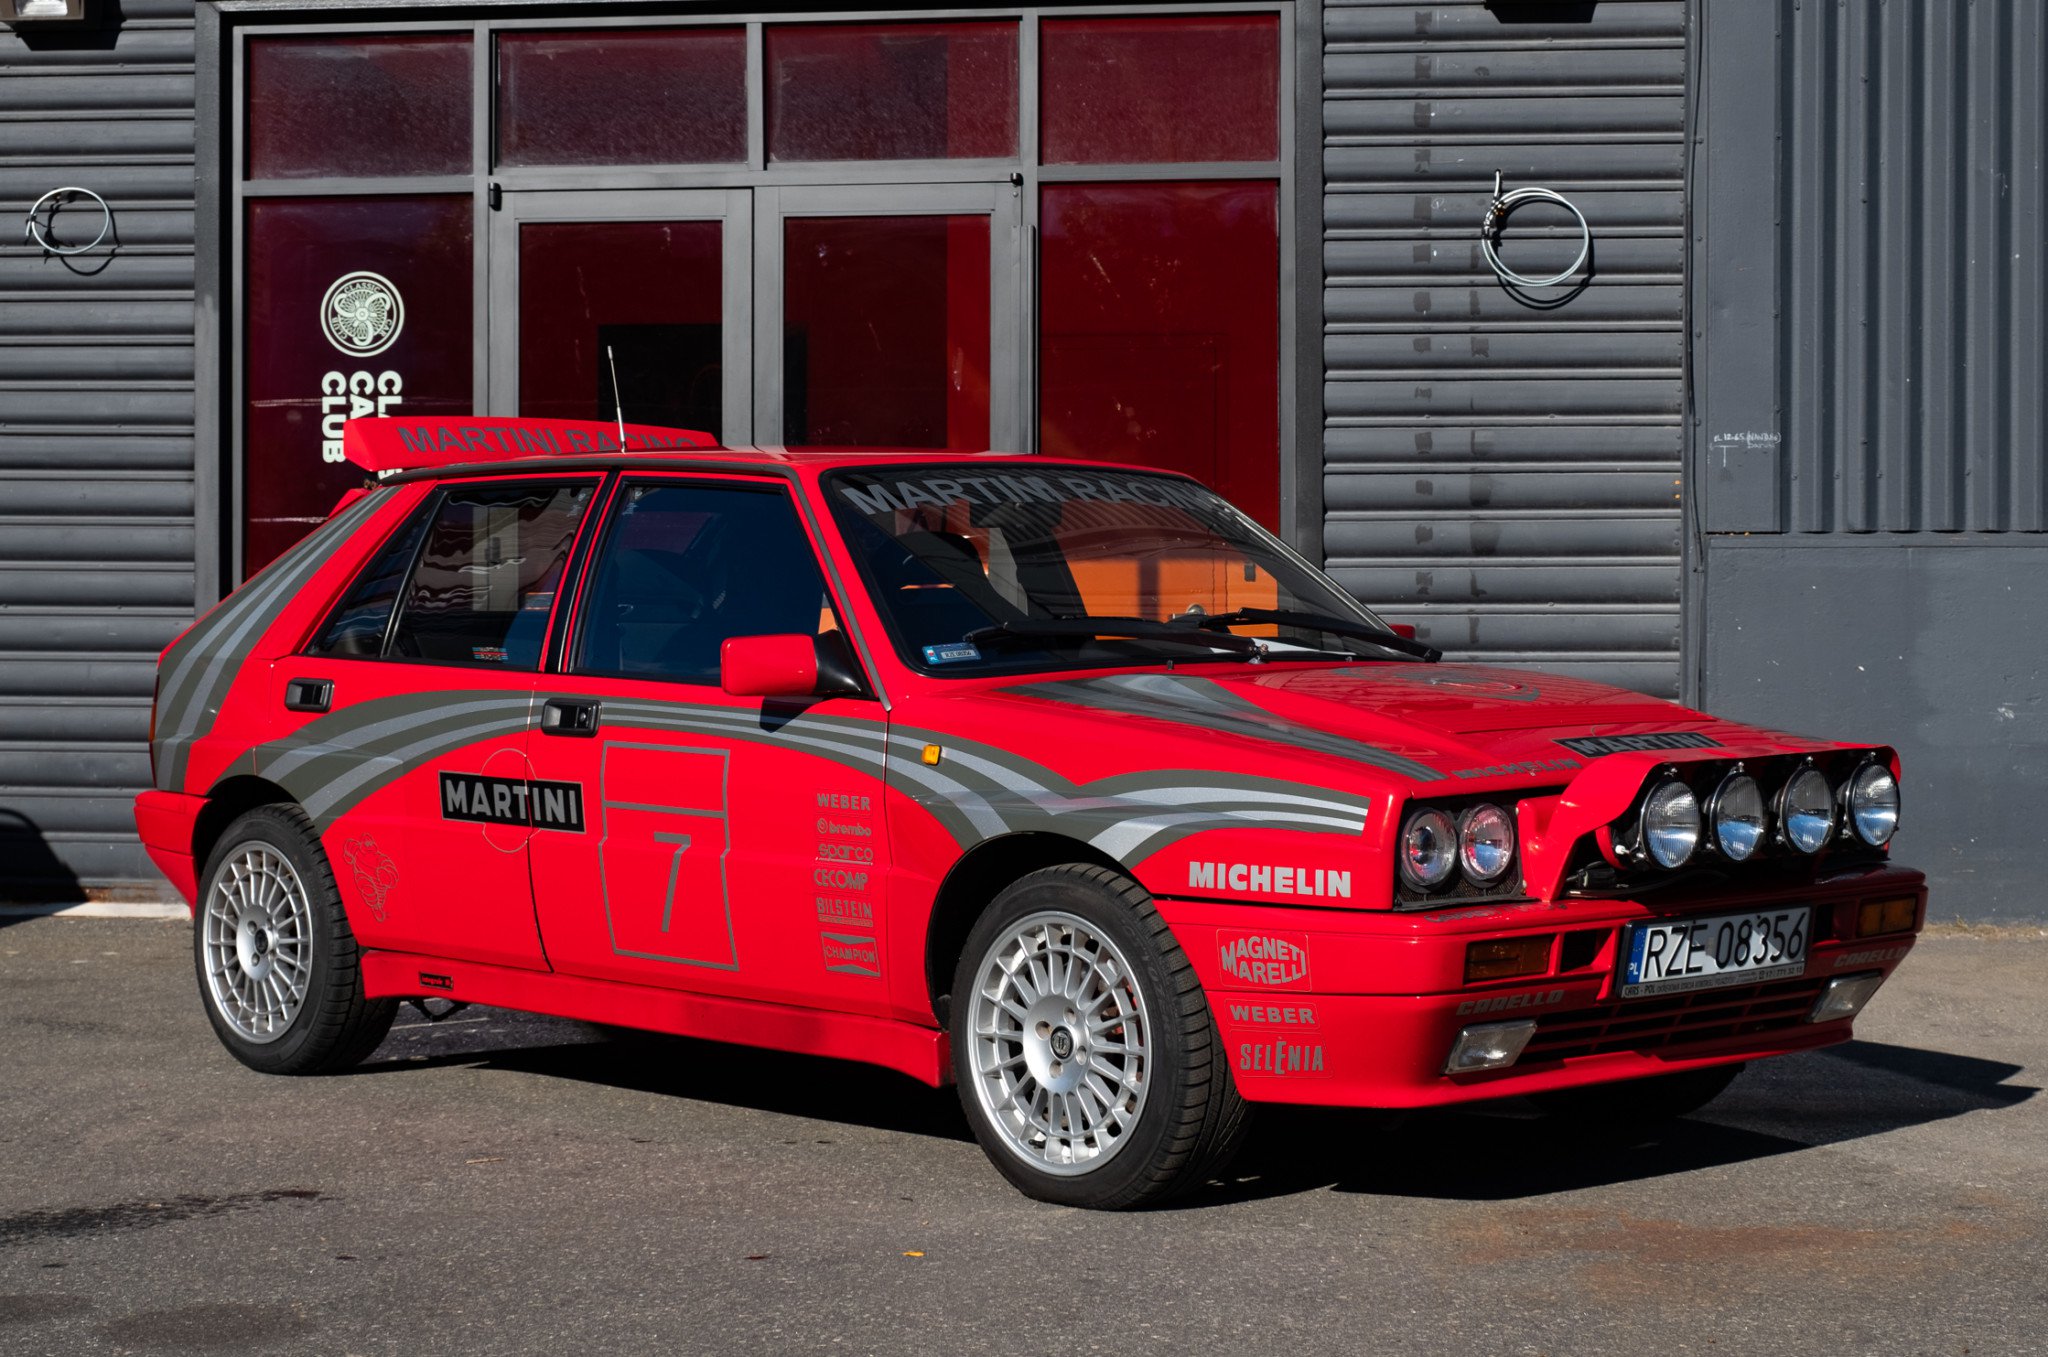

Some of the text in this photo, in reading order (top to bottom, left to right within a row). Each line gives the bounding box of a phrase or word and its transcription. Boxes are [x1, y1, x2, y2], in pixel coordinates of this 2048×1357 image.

[344, 282, 381, 294] CLASSIC
[321, 370, 347, 463] CLUB
[397, 427, 562, 453] MARTINI
[840, 475, 1068, 515] MARTINI
[1566, 735, 1721, 754] MARTINI
[1451, 758, 1582, 780] MICHELIN
[445, 779, 578, 825] MARTINI
[817, 793, 871, 811] WEBER
[829, 820, 872, 837] brembo
[653, 831, 692, 933] 7
[813, 868, 869, 891] CECOMP
[1189, 861, 1351, 898] MICHELIN
[816, 897, 873, 919] BILSTEIN
[825, 945, 876, 963] CHAMPION
[1221, 936, 1306, 970] MAGNETI
[1643, 911, 1807, 979] RZE 08356
[1221, 945, 1306, 985] MARELLI
[1627, 962, 1639, 975] PL
[1230, 1004, 1315, 1024] WEBER
[1456, 990, 1564, 1016] CARELLO
